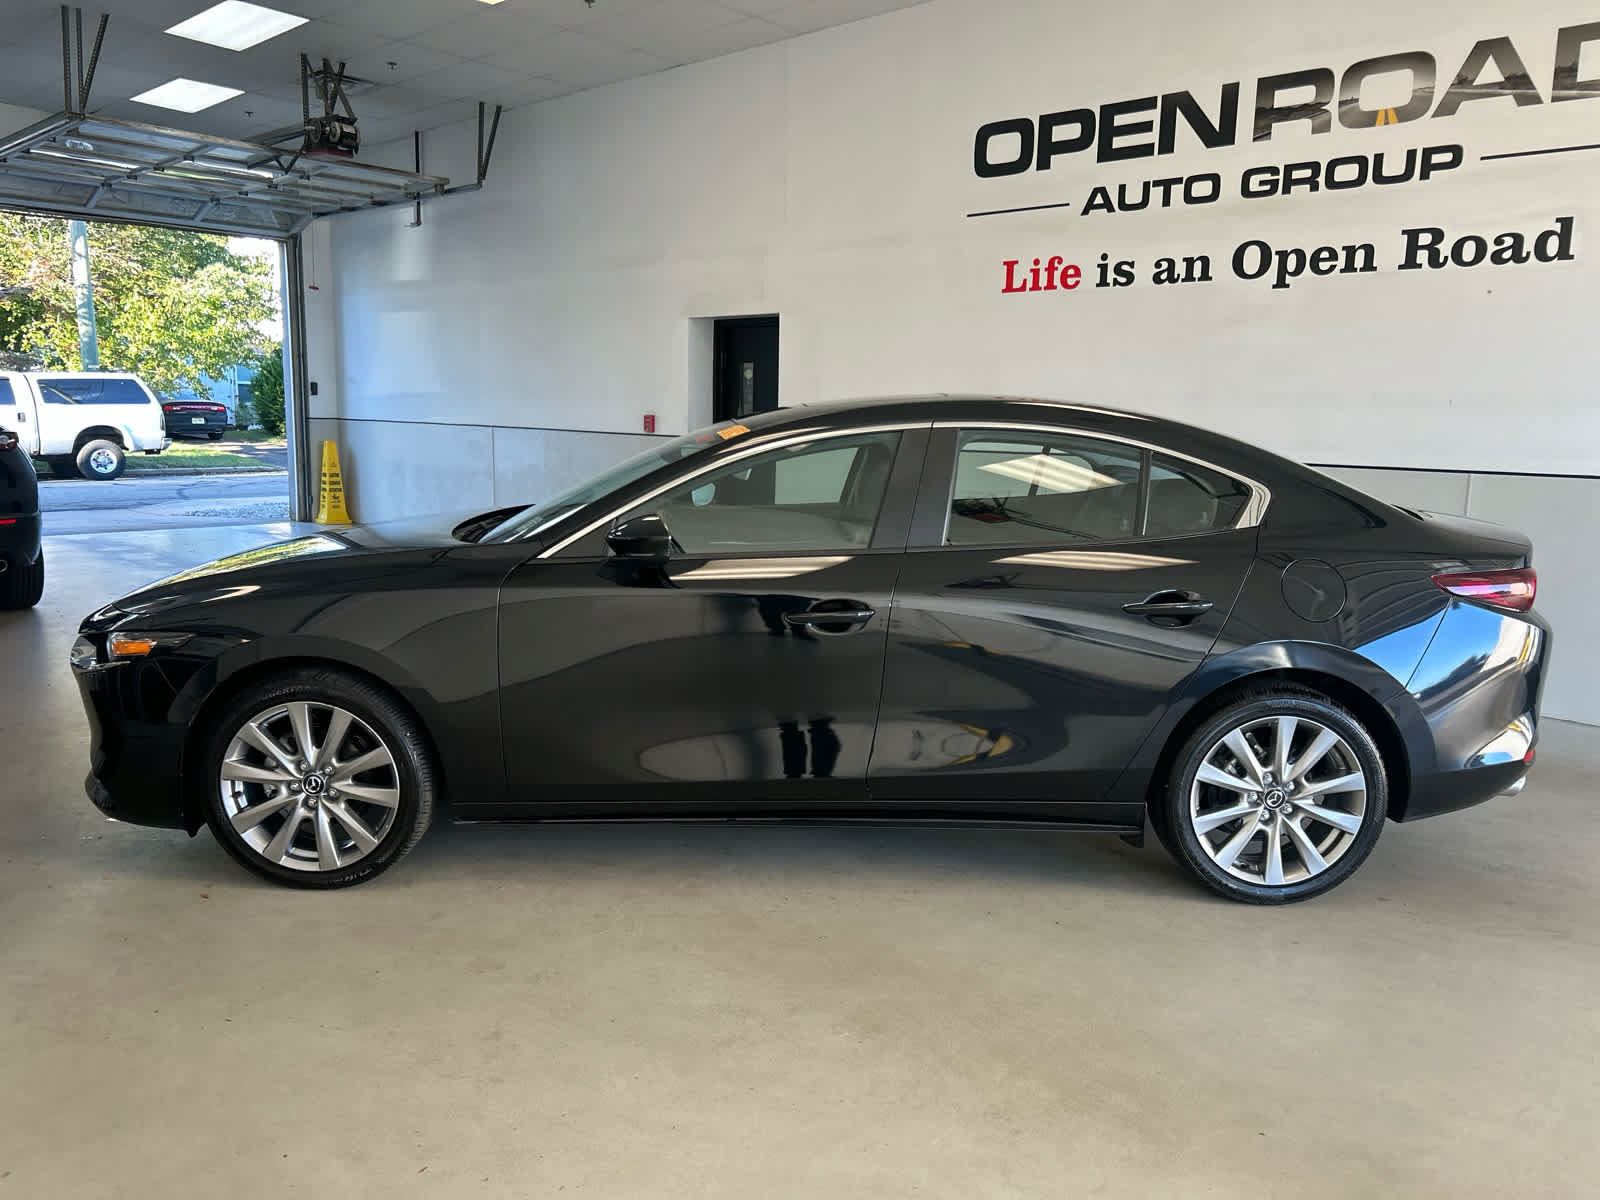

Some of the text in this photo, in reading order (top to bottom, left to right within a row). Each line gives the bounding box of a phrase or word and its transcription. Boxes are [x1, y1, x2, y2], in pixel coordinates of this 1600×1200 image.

[973, 81, 1240, 179] OPEN
[1079, 143, 1464, 217] AUTO GROUP
[1001, 215, 1575, 294] Life is an Open Road
